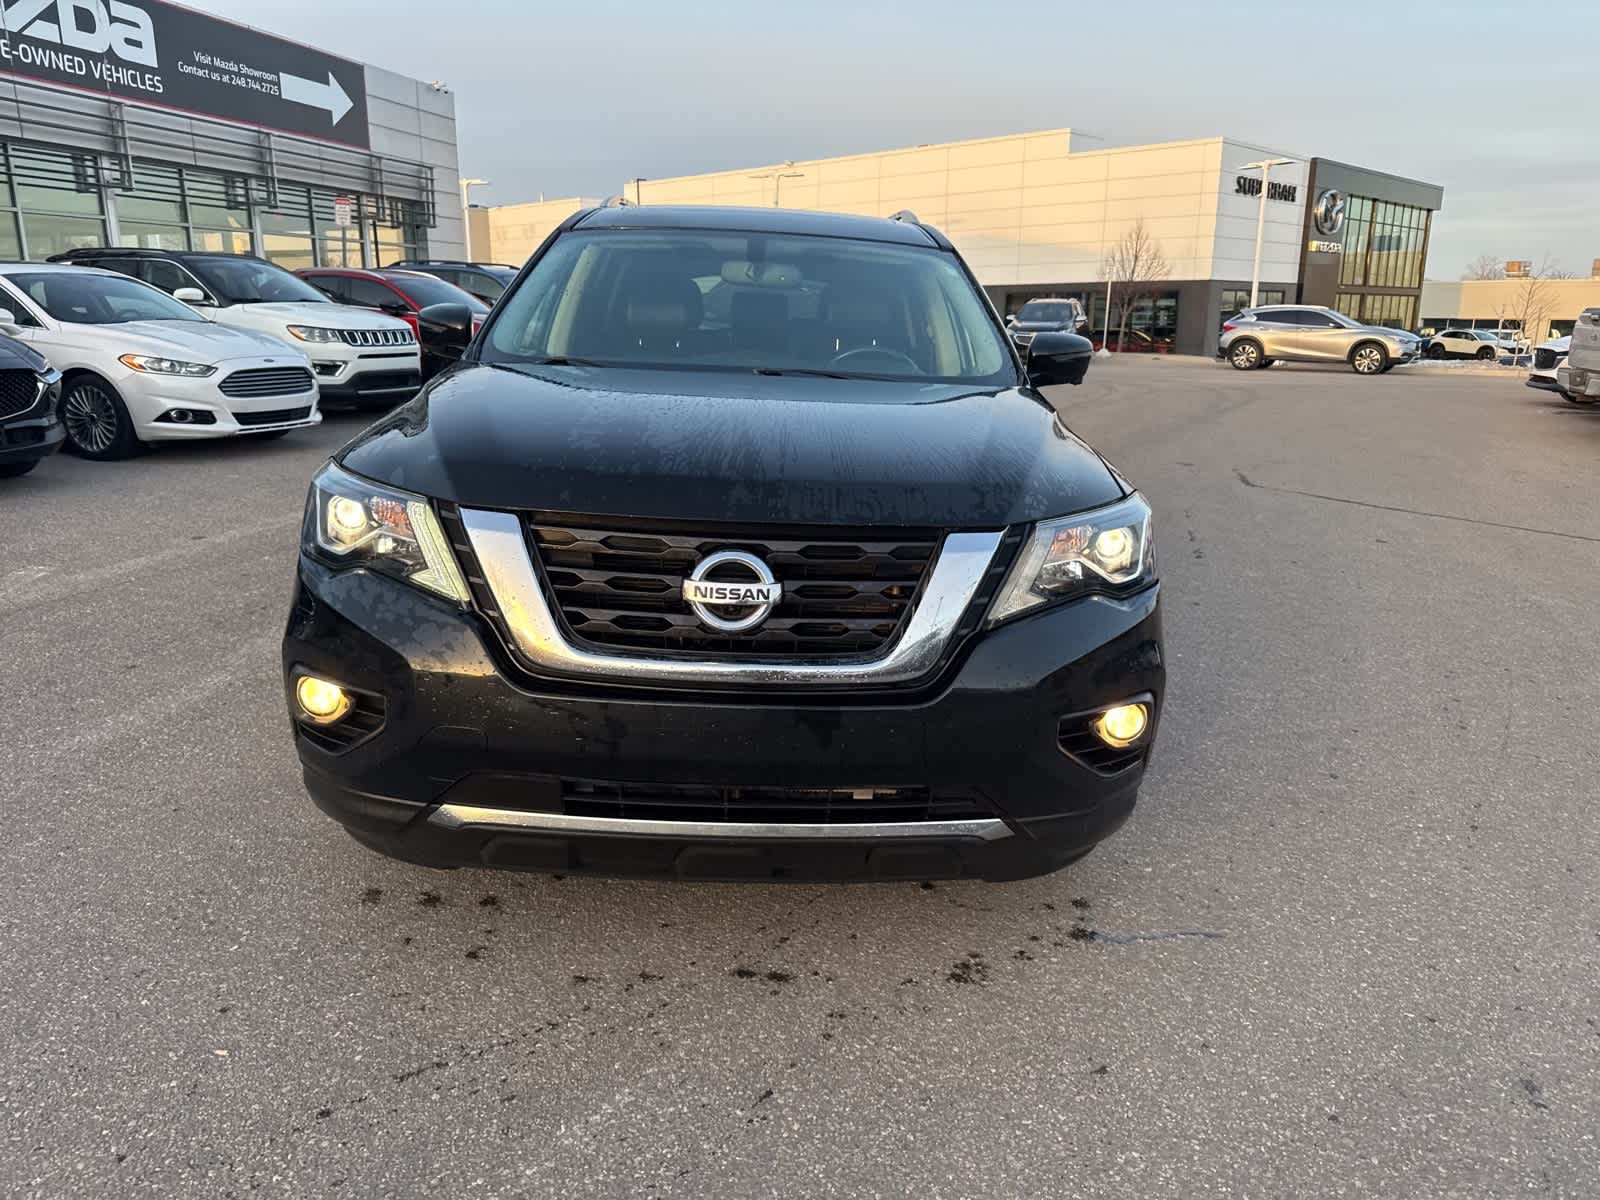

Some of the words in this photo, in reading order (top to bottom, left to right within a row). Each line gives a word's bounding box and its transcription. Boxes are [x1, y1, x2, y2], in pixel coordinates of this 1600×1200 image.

[90, 59, 164, 93] VEHICLES
[177, 61, 209, 79] Contact
[210, 71, 220, 81] us
[221, 74, 230, 84] at
[230, 74, 280, 96] 248.744.2725
[193, 51, 211, 65] Visit
[213, 55, 238, 72] Mazda
[239, 63, 278, 82] Showroom
[693, 585, 770, 601] NISSAN
